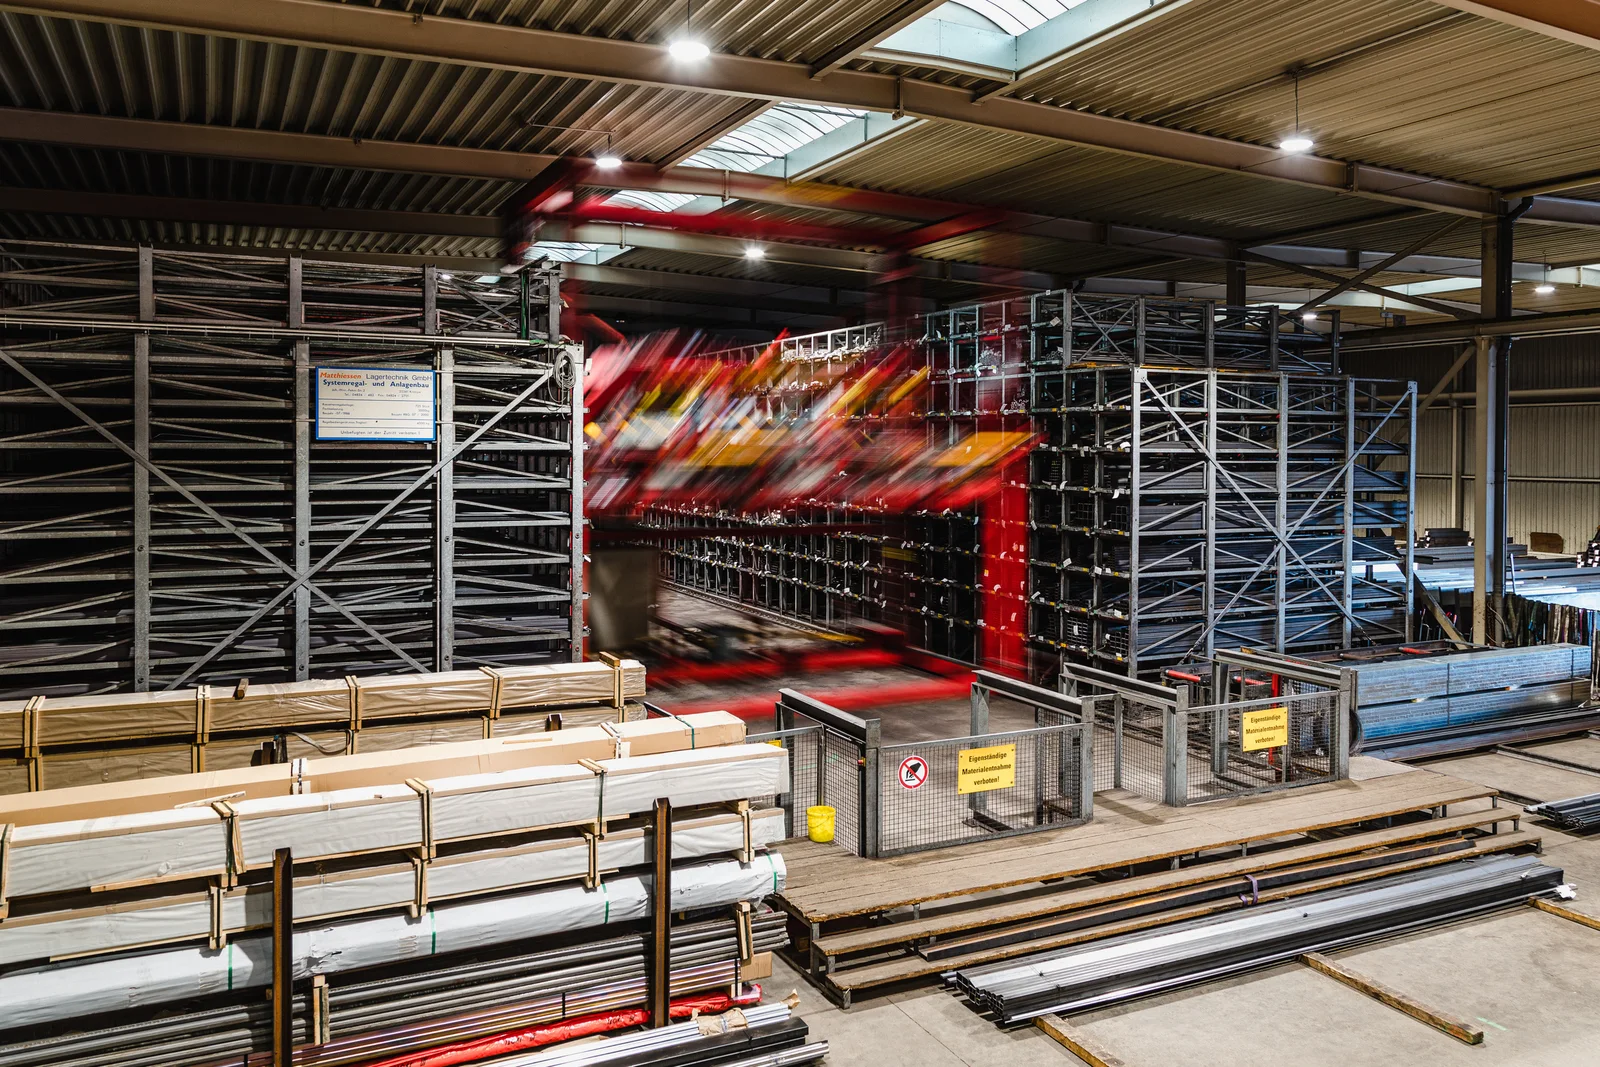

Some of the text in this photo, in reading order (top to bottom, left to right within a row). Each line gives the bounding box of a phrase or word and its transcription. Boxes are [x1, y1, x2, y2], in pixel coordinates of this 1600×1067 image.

[1251, 714, 1281, 724] Eigenständige
[1246, 725, 1284, 734] Materialentnahme
[968, 752, 1007, 762] Eigenständige
[962, 763, 1012, 775] Materialentnahme
[974, 776, 1000, 786] verboten!
